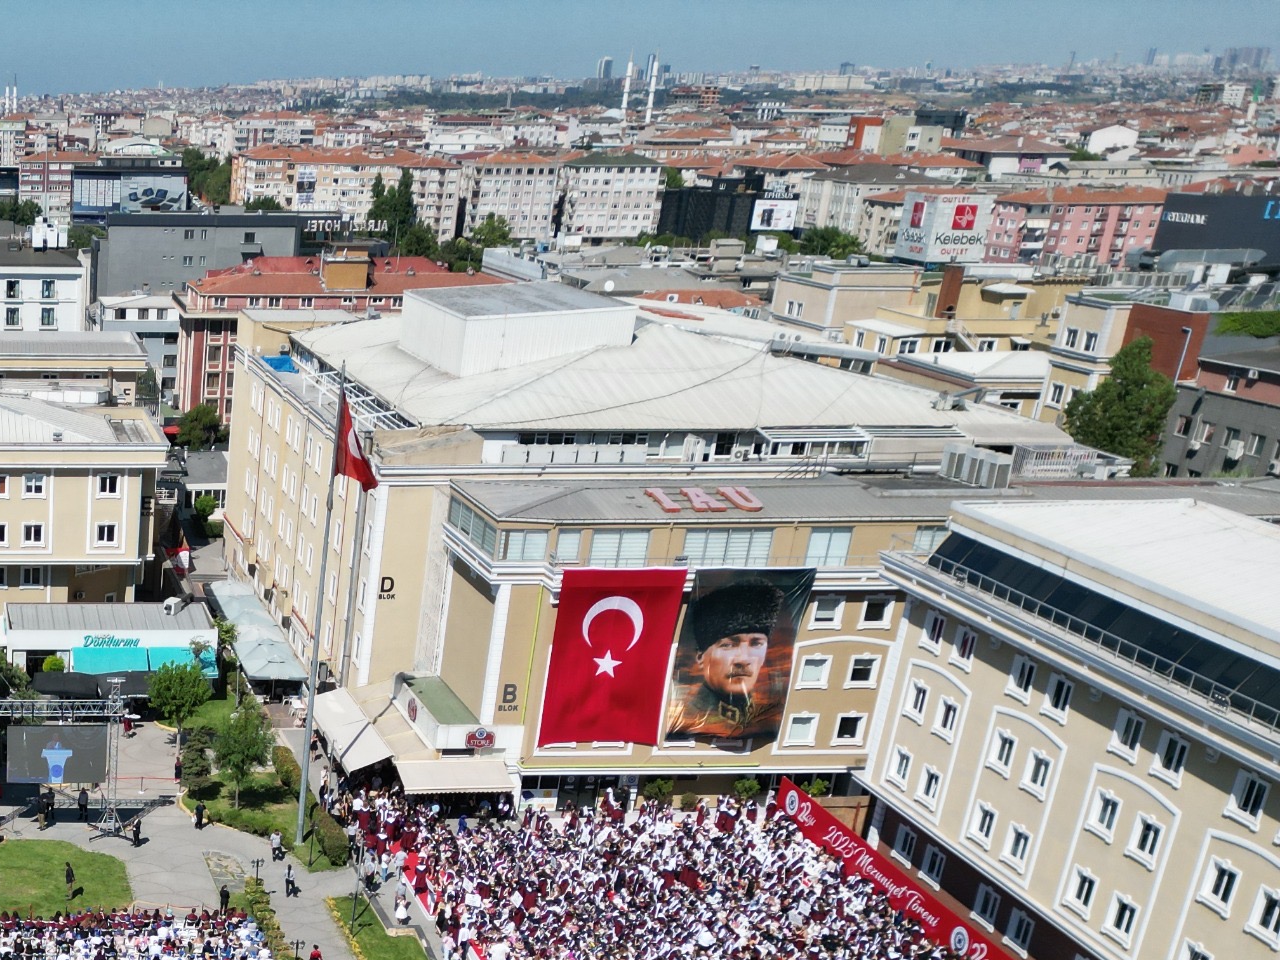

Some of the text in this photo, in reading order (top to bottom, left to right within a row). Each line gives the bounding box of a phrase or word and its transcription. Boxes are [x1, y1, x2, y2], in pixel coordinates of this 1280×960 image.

[934, 232, 984, 245] Kelebek
[644, 486, 763, 513] IAU
[380, 576, 395, 593] D
[83, 635, 140, 648] Dondurma
[502, 683, 518, 703] B
[498, 704, 519, 712] BLOK
[470, 739, 491, 747] STORE
[822, 825, 941, 928] 2025 Mezuniyet Töreni
